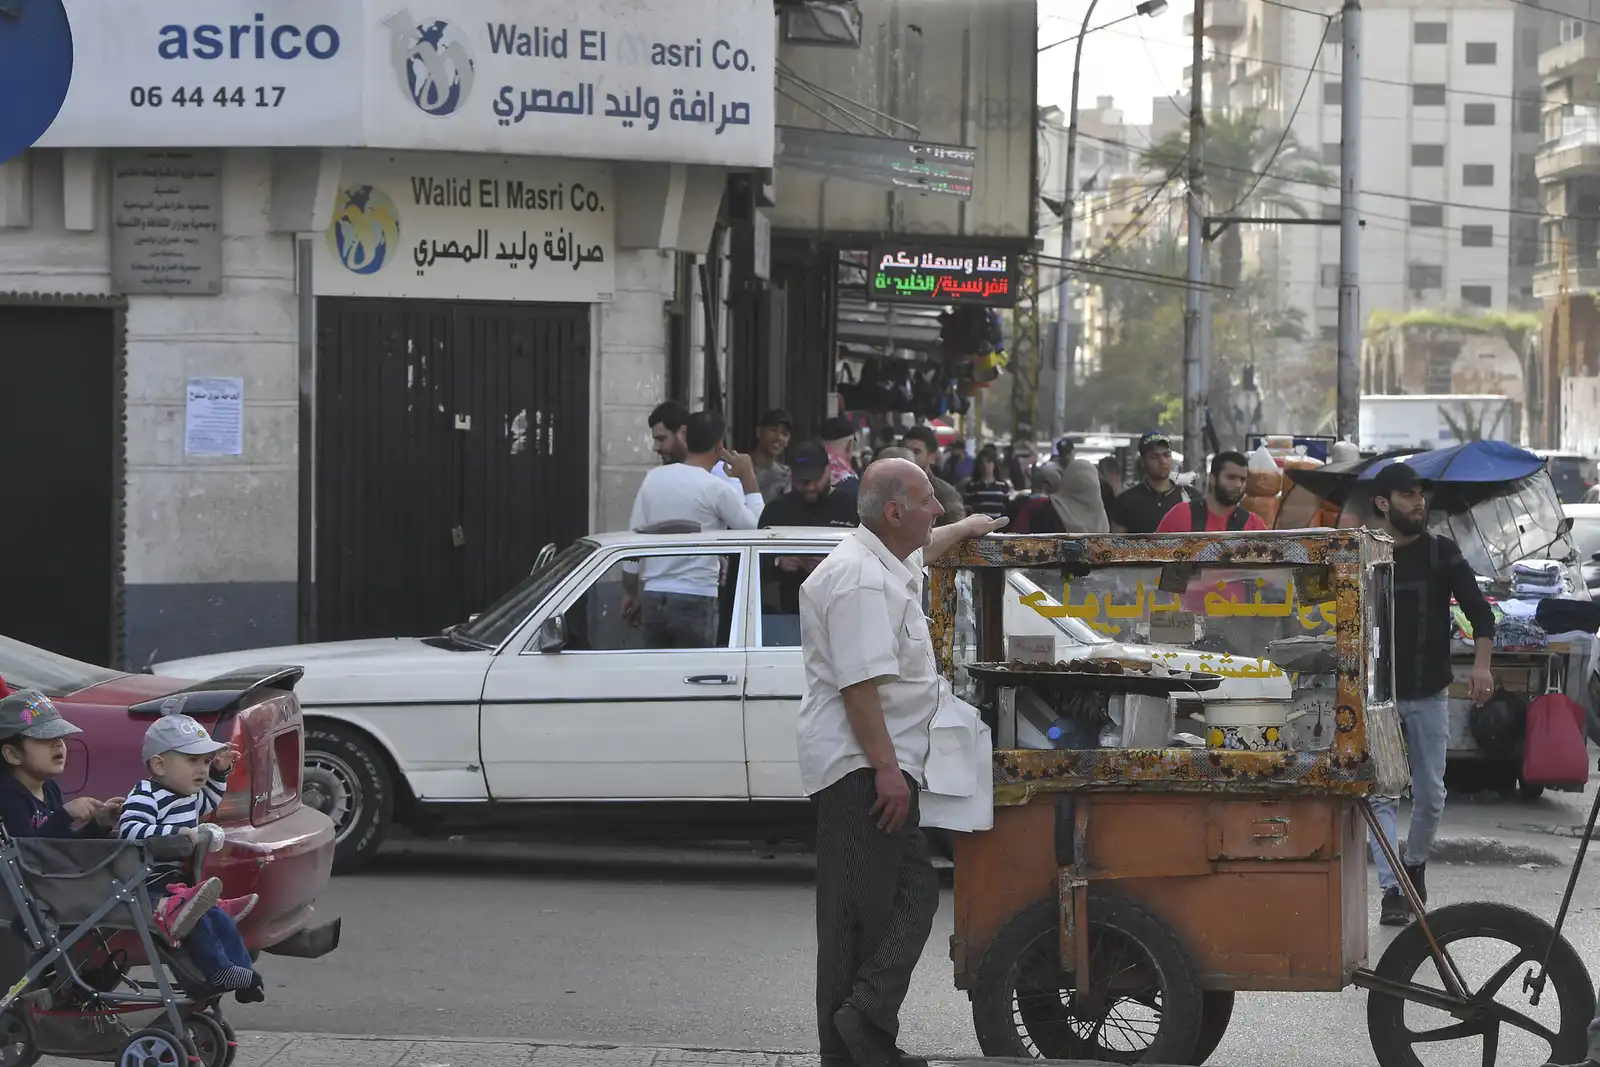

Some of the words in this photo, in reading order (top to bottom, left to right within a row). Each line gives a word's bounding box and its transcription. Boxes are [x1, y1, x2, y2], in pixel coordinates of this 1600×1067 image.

[157, 12, 340, 60] asrico
[486, 22, 568, 59] Walid
[579, 29, 606, 62] El
[711, 39, 756, 72] Co.
[130, 85, 163, 108] 06
[171, 85, 205, 108] 44
[212, 85, 246, 108] 44
[255, 85, 286, 108] 17
[492, 82, 594, 127] المصري
[604, 86, 660, 131] وليد
[669, 88, 750, 135] صرافة
[411, 176, 471, 207] Walid
[479, 179, 499, 208] El
[506, 180, 563, 210] Masri
[570, 183, 604, 212] Co.
[413, 228, 489, 276] المصري
[495, 230, 538, 269] وليد
[543, 227, 604, 270] صرافة
[879, 251, 919, 274] بكم
[920, 252, 973, 274] وسهلا
